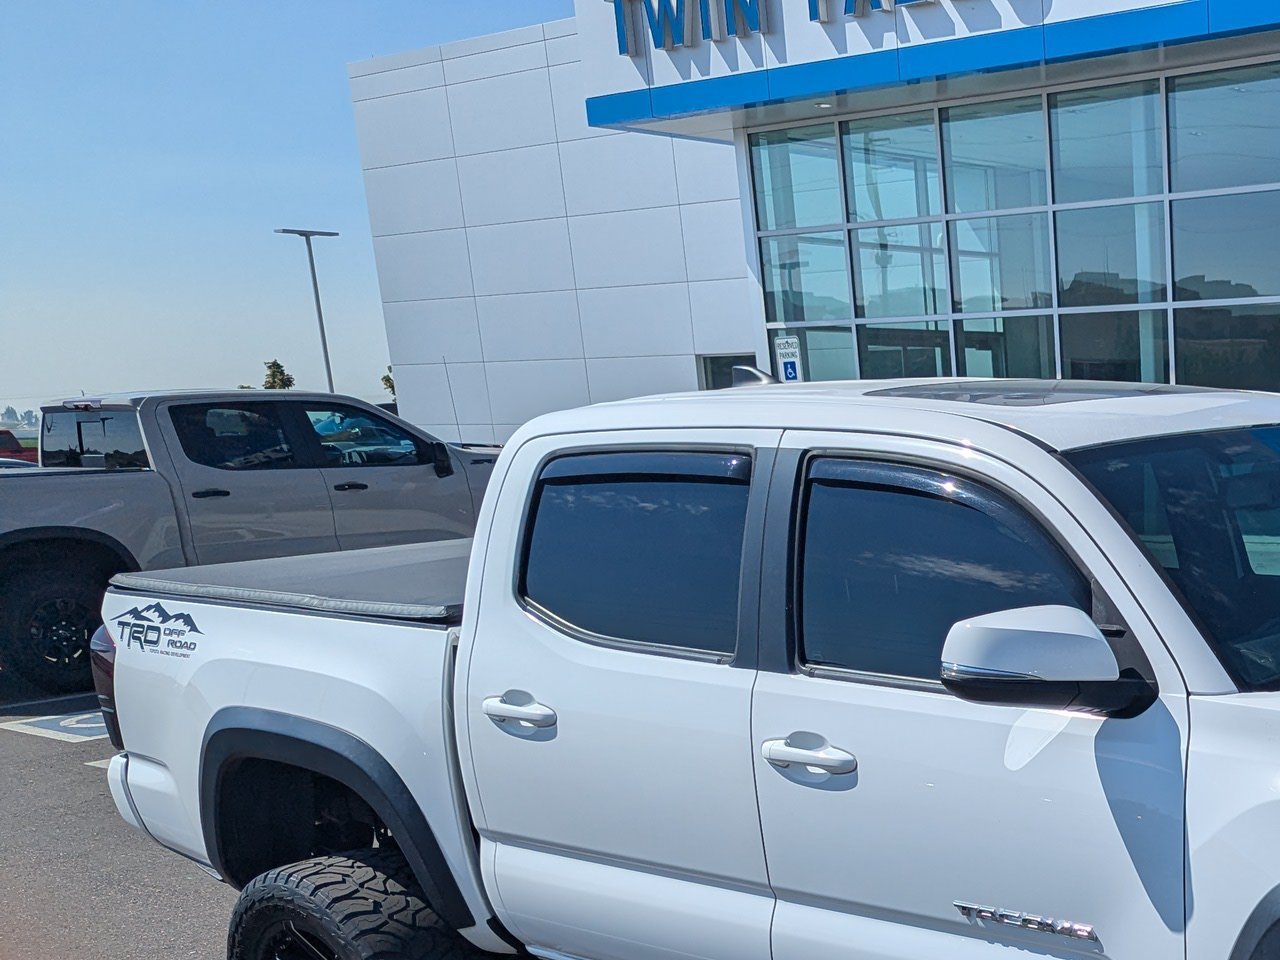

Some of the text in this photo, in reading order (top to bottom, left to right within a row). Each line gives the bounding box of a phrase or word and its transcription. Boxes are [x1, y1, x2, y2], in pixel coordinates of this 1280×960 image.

[779, 351, 798, 359] PARKING
[117, 620, 186, 652] TRD OFF
[167, 639, 197, 651] ROAD
